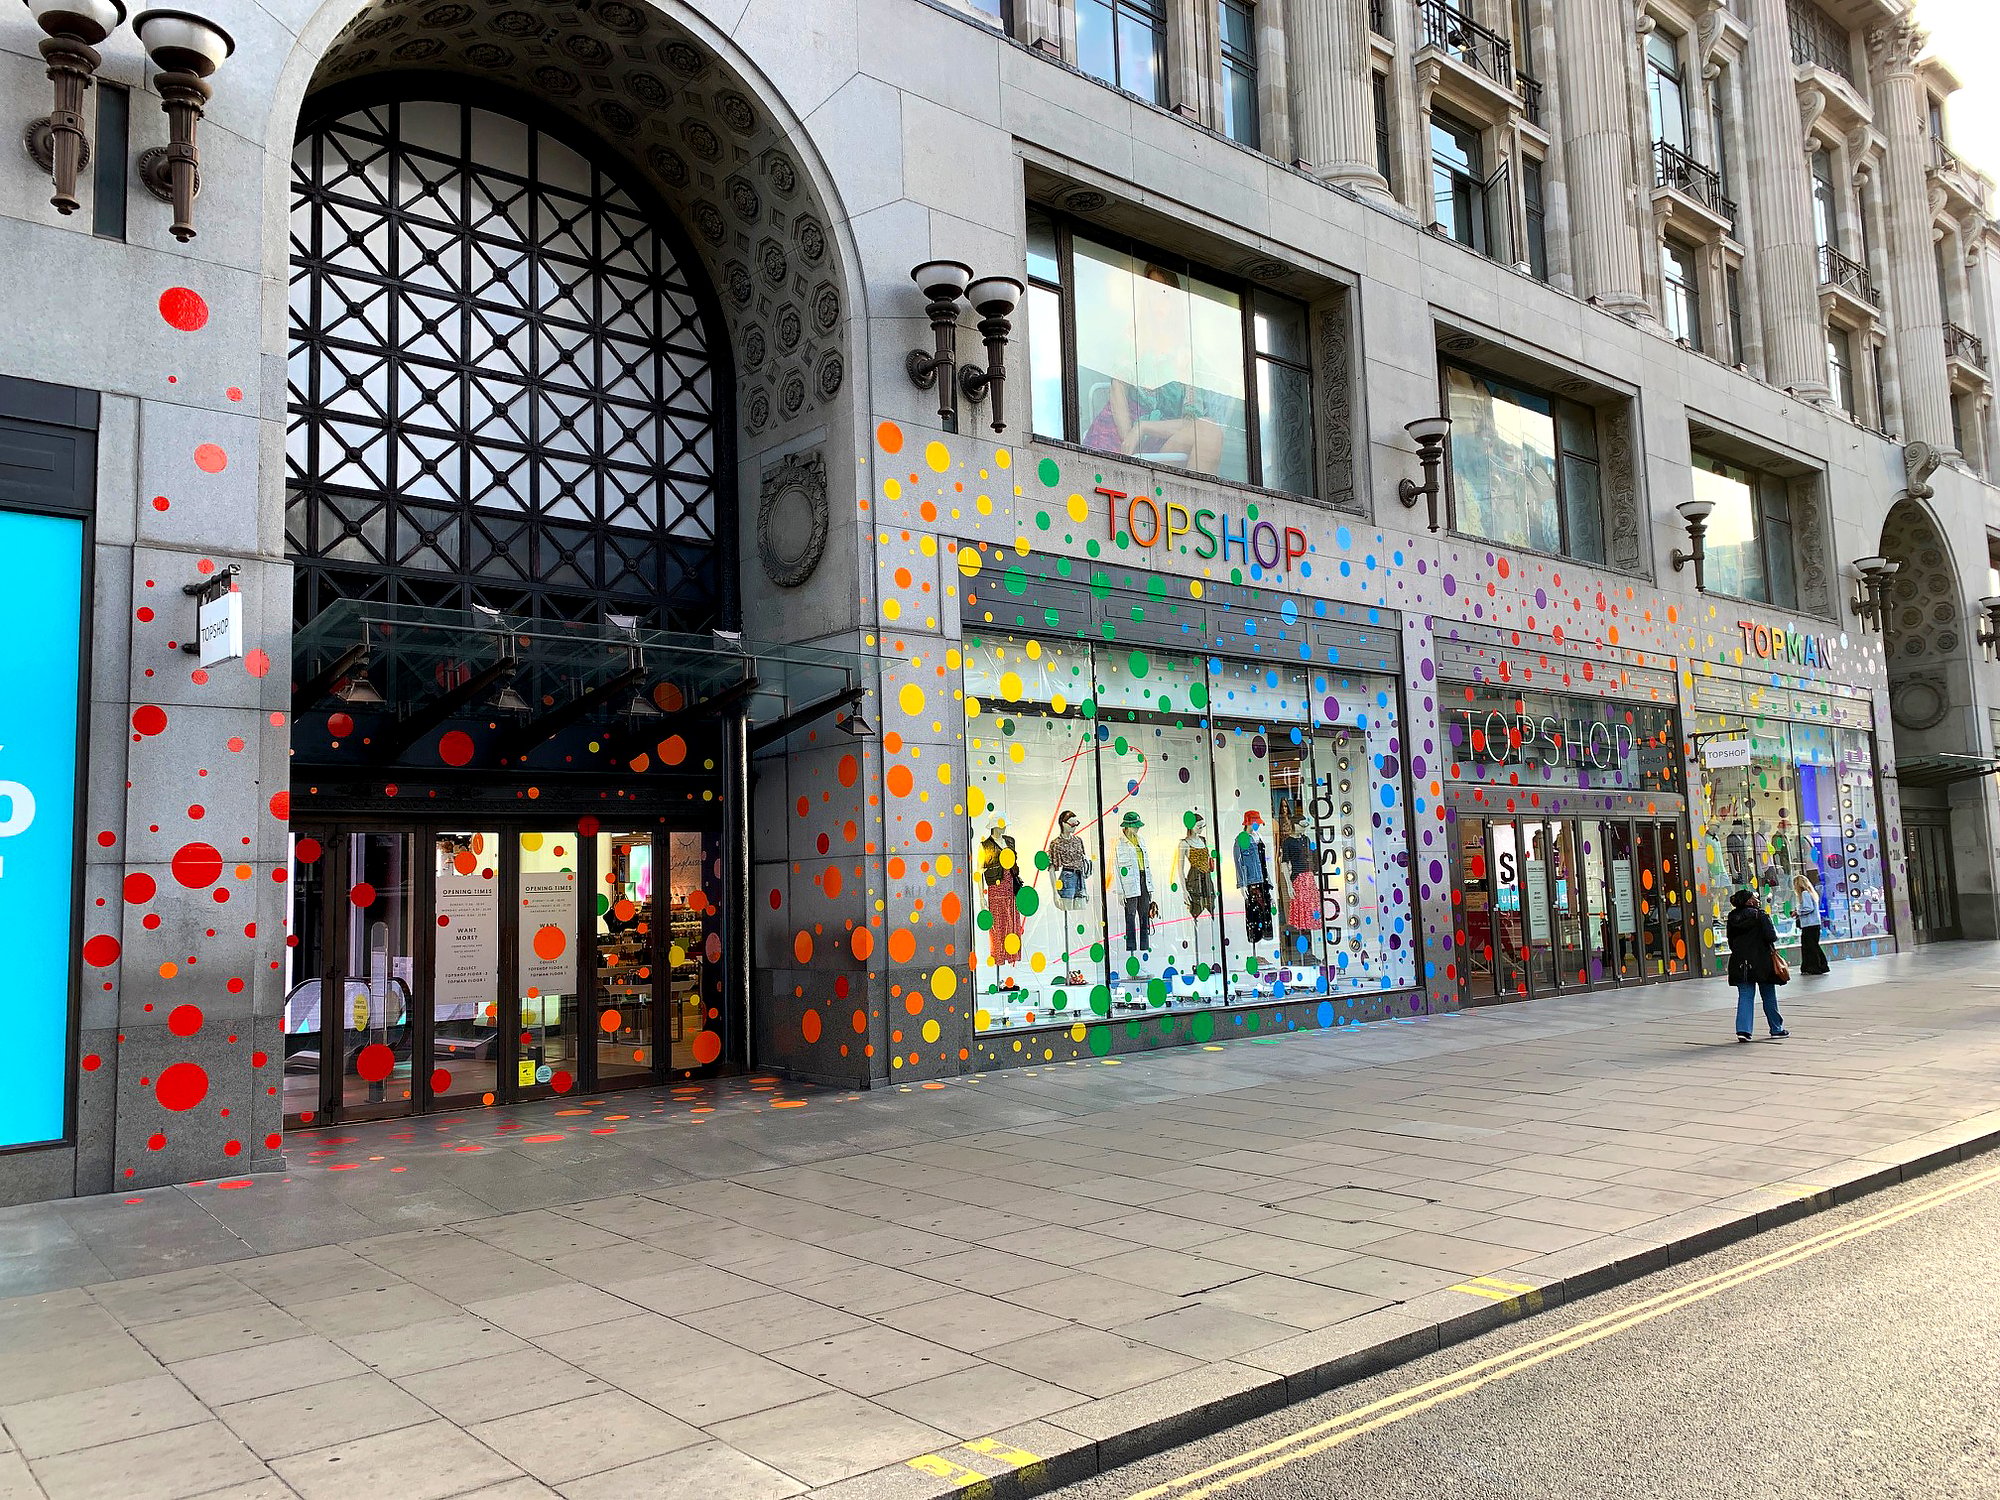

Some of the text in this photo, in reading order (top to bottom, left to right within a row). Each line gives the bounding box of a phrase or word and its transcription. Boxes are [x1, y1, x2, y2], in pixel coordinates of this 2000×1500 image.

[1095, 487, 1307, 571] TOPSHOP
[201, 617, 229, 642] TOPSHOP
[1737, 620, 1833, 670] TOPMAN
[1456, 709, 1633, 769] TOPSHOP
[1707, 749, 1746, 759] TOPSHOP
[1308, 772, 1342, 946] TOPSHOP
